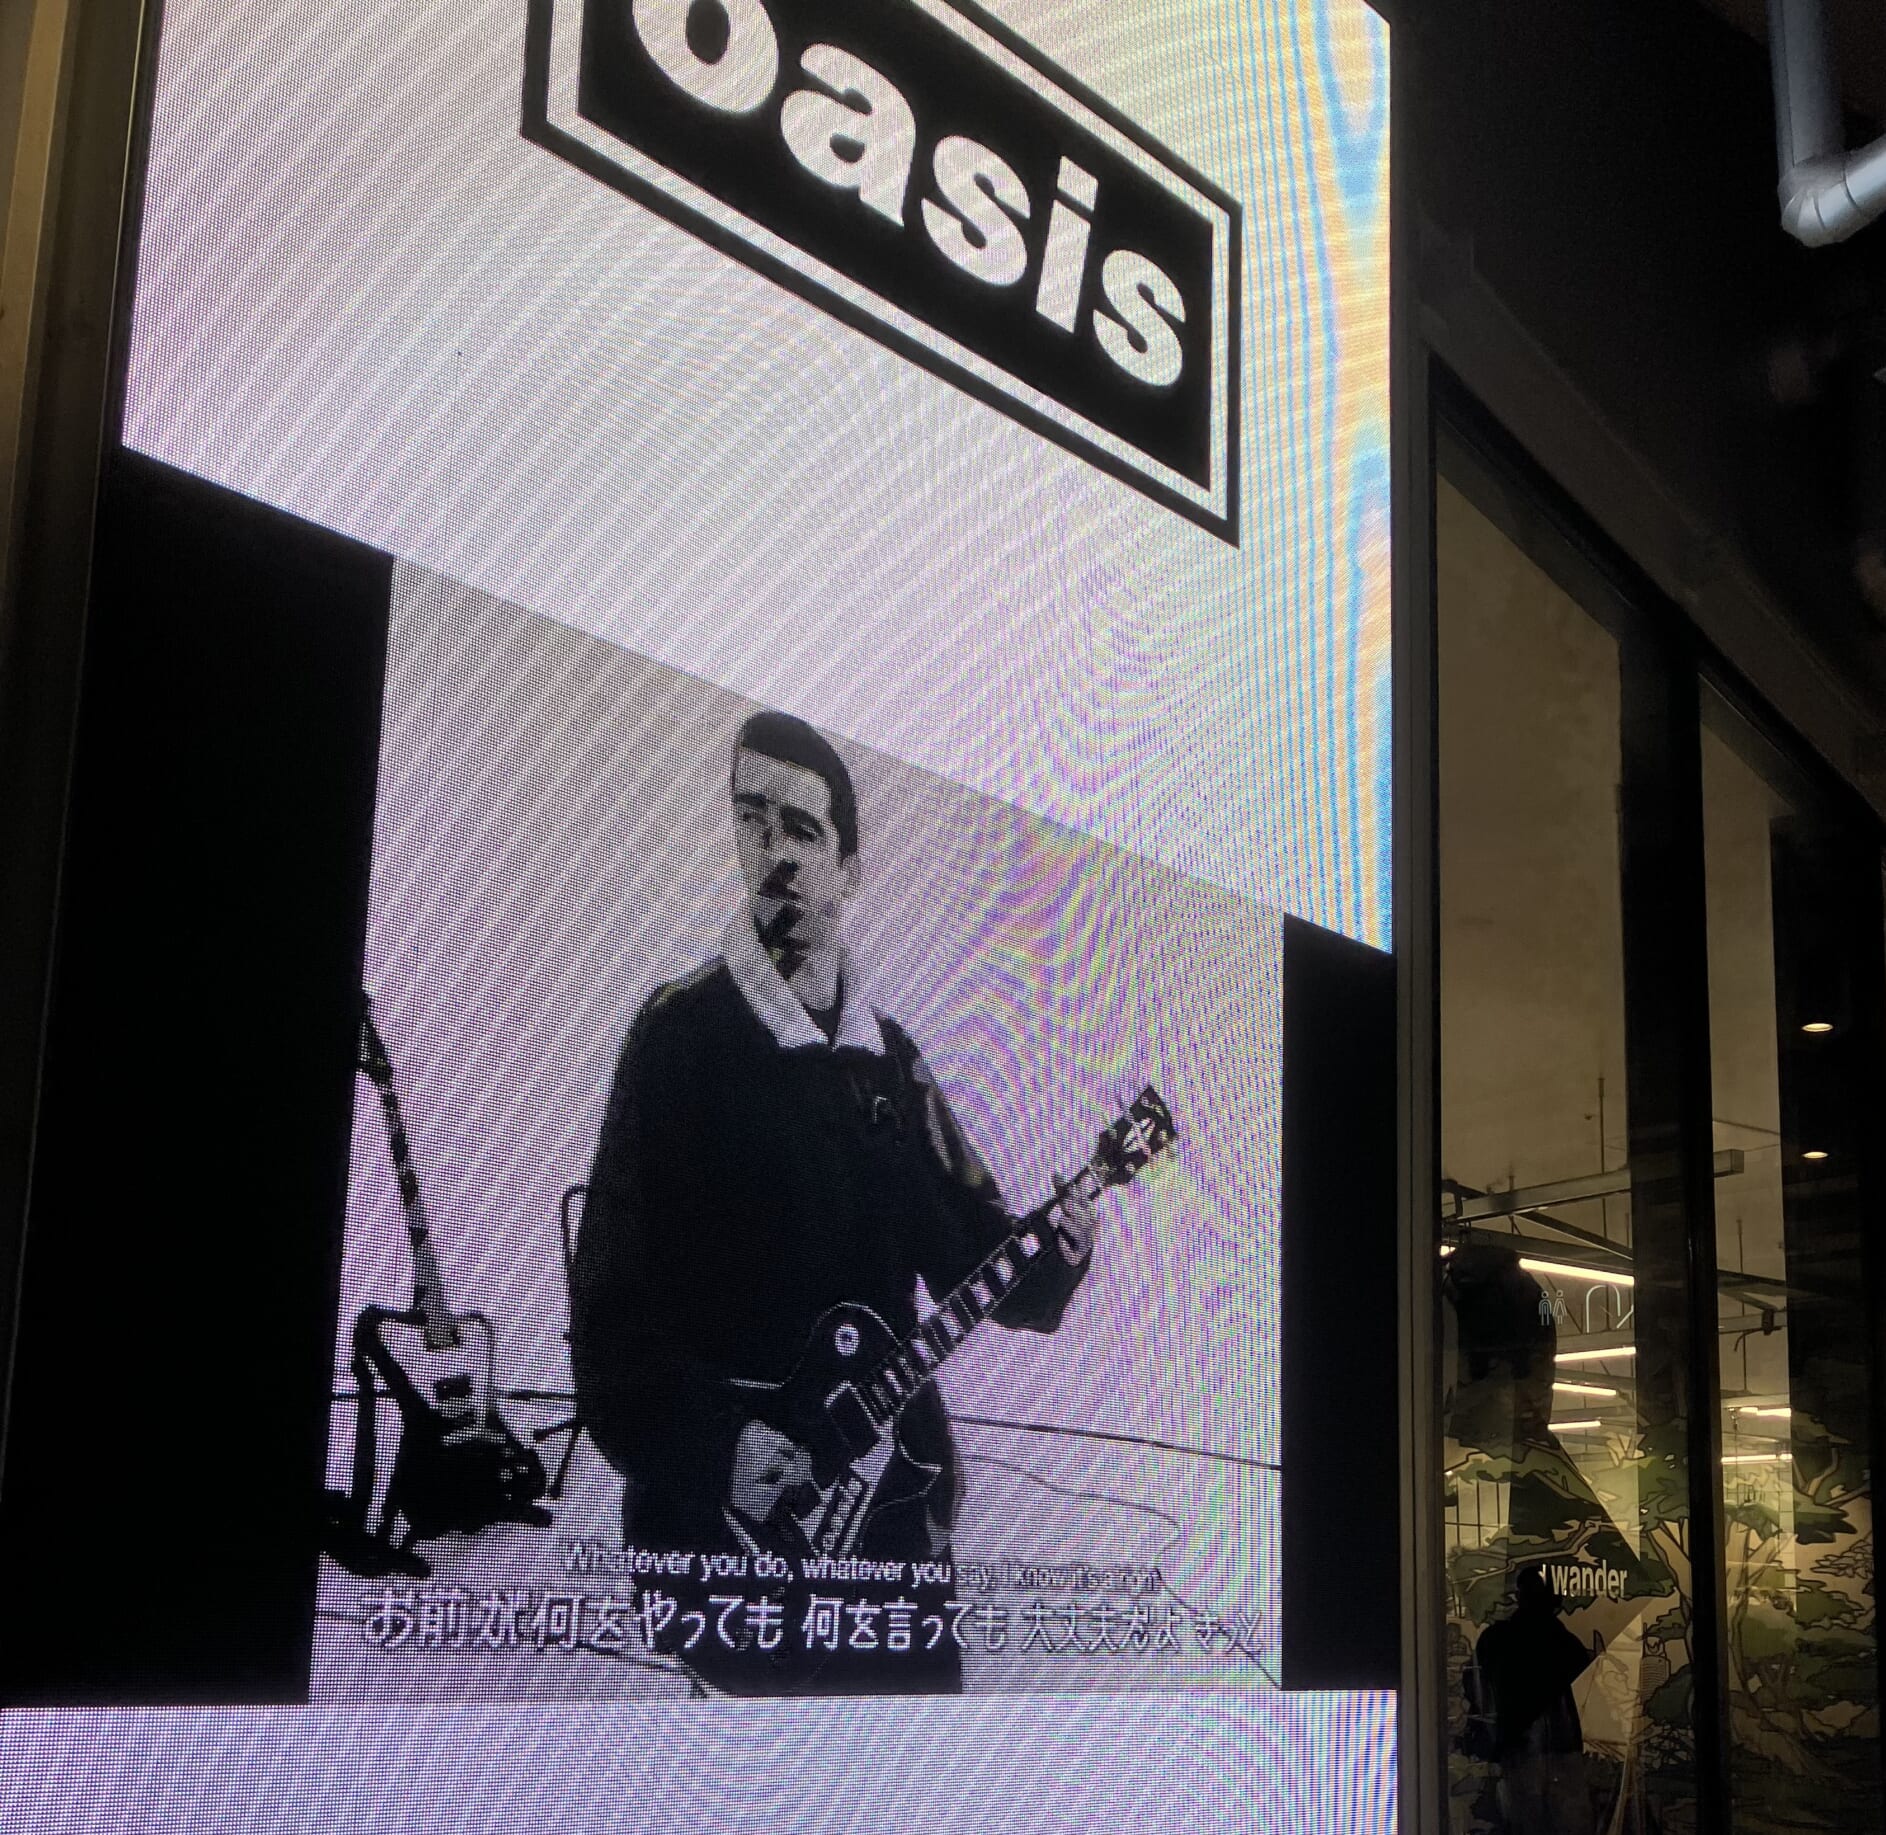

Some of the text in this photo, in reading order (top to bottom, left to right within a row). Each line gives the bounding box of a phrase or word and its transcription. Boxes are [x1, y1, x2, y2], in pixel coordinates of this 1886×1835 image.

[633, 0, 1186, 386] oasis
[563, 1541, 696, 1574] Whatever
[700, 1553, 747, 1582] you
[755, 1550, 794, 1583] do,
[801, 1554, 906, 1581] whatever
[911, 1561, 951, 1589] you
[1551, 1560, 1628, 1599] wander
[361, 1587, 784, 1650] お前が何をやっても
[801, 1594, 1007, 1650] 何を言っても
[1022, 1599, 1181, 1652] 大丈夫だよ
